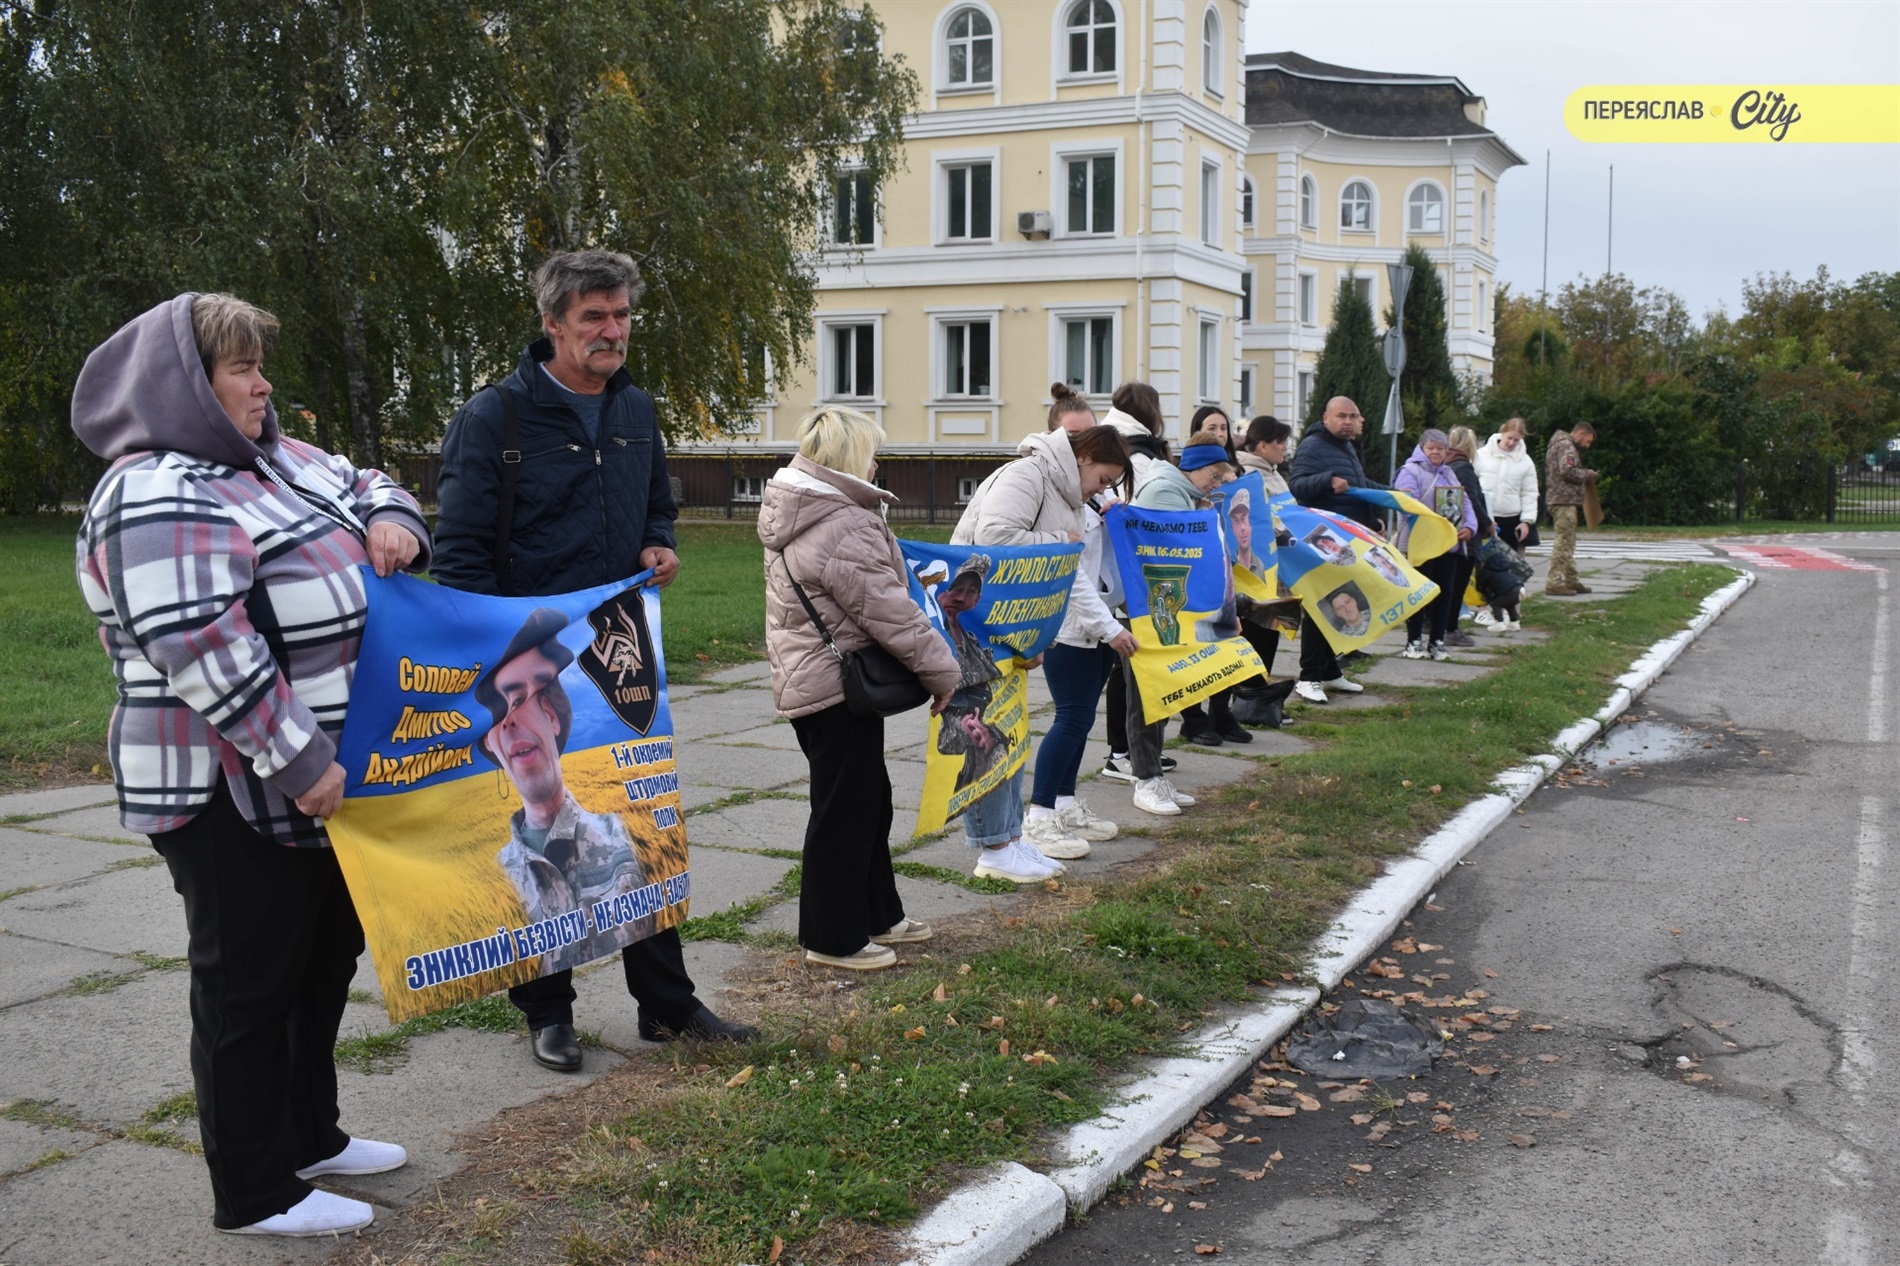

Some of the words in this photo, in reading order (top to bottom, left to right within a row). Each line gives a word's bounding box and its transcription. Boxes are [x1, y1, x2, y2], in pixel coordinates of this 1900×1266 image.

[987, 556, 1047, 584] ЖУРИЛО
[1380, 600, 1404, 625] 137
[1199, 644, 1220, 659] ОШП
[399, 656, 481, 694] Соловей
[1161, 689, 1184, 706] ТЕБЕ
[1185, 672, 1223, 694] ЧЕКАЮТЬ
[1220, 659, 1245, 677] ВДОМА!
[391, 705, 472, 744] Дмитро
[610, 742, 633, 769] 1-й
[631, 736, 674, 766] окремий
[653, 805, 677, 830] полк
[406, 926, 514, 990] ЗНИКЛИЙ
[512, 908, 588, 961] БЕЗВІСТИ
[592, 899, 613, 933] НЕ
